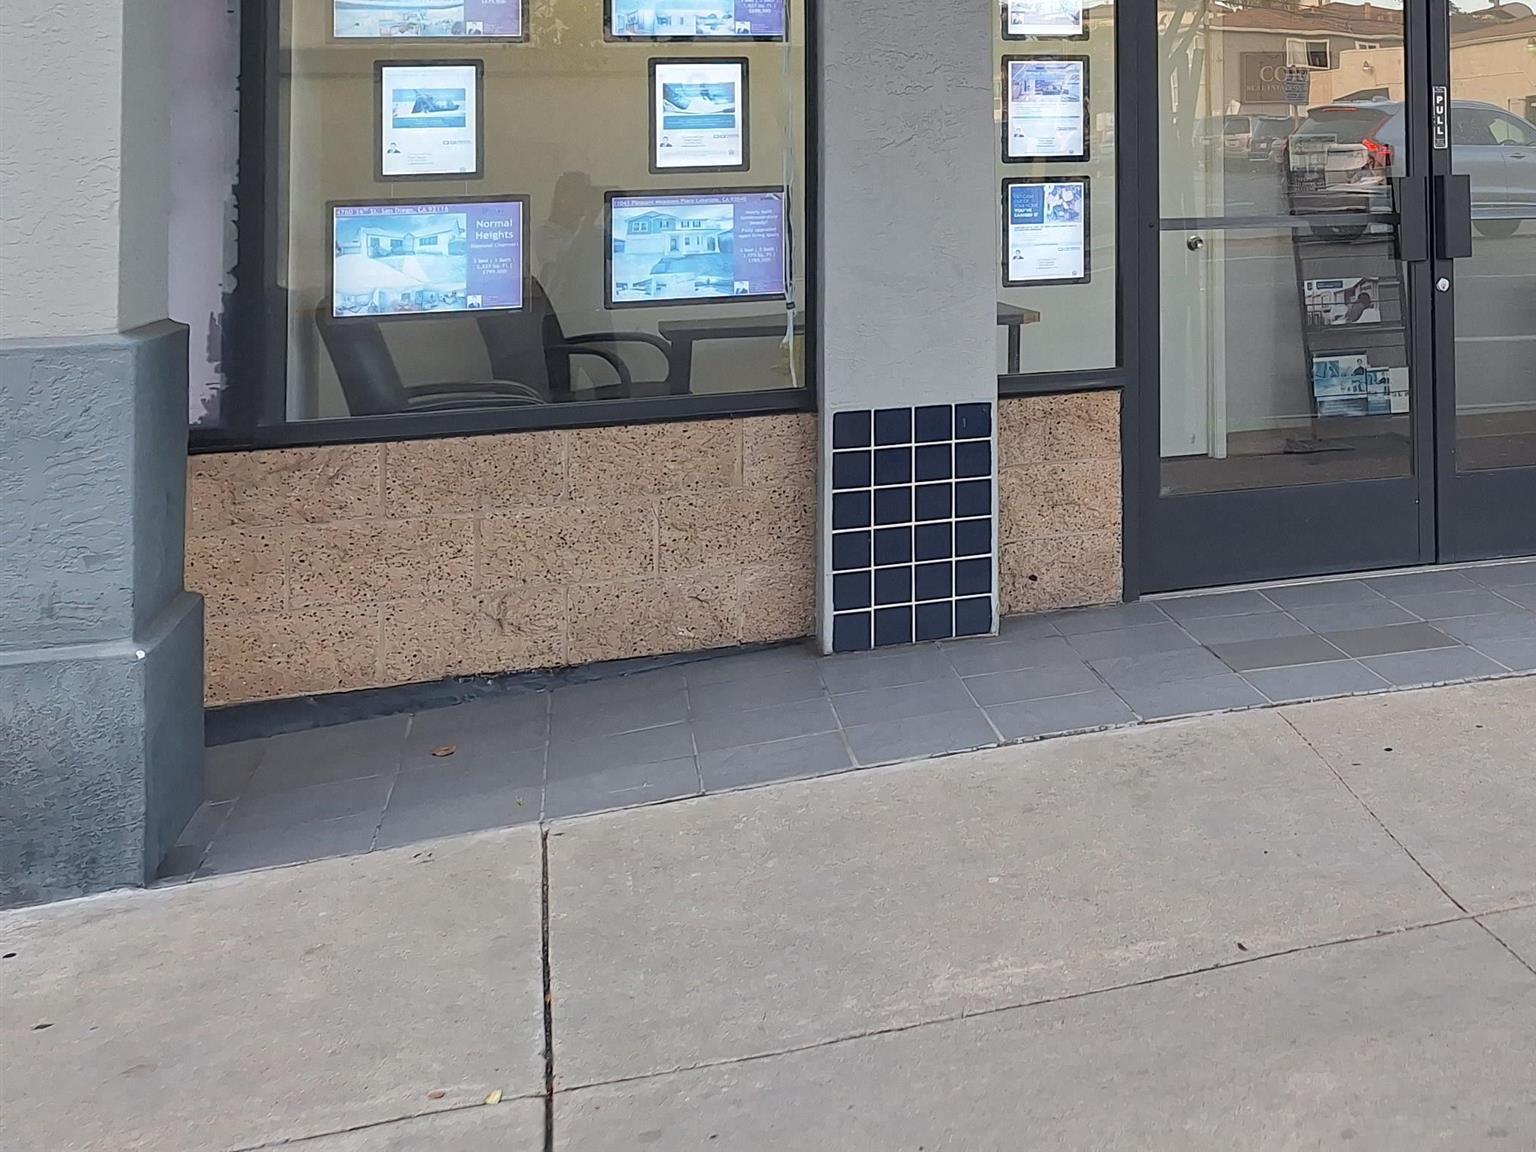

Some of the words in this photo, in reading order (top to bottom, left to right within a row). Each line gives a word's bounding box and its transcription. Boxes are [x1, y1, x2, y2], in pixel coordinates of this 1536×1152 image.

[1436, 95, 1444, 135] PULL
[476, 218, 513, 229] Normal
[475, 230, 514, 241] Heights
